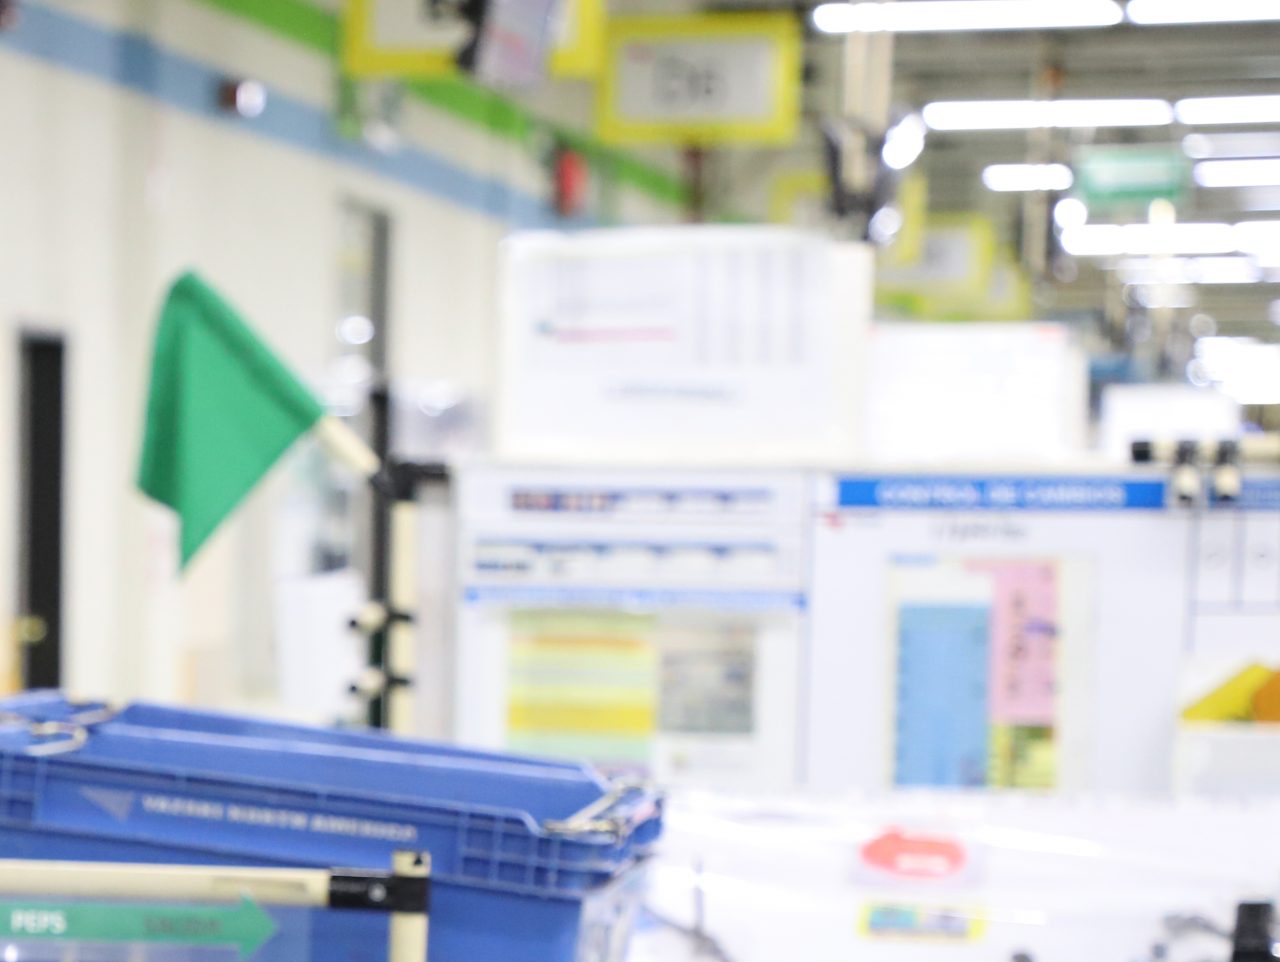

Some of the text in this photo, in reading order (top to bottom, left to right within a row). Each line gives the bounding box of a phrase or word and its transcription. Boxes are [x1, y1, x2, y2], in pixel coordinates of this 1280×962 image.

[227, 804, 308, 831] NORTH
[311, 814, 417, 842] AMERICA
[11, 910, 67, 934] PEPS
